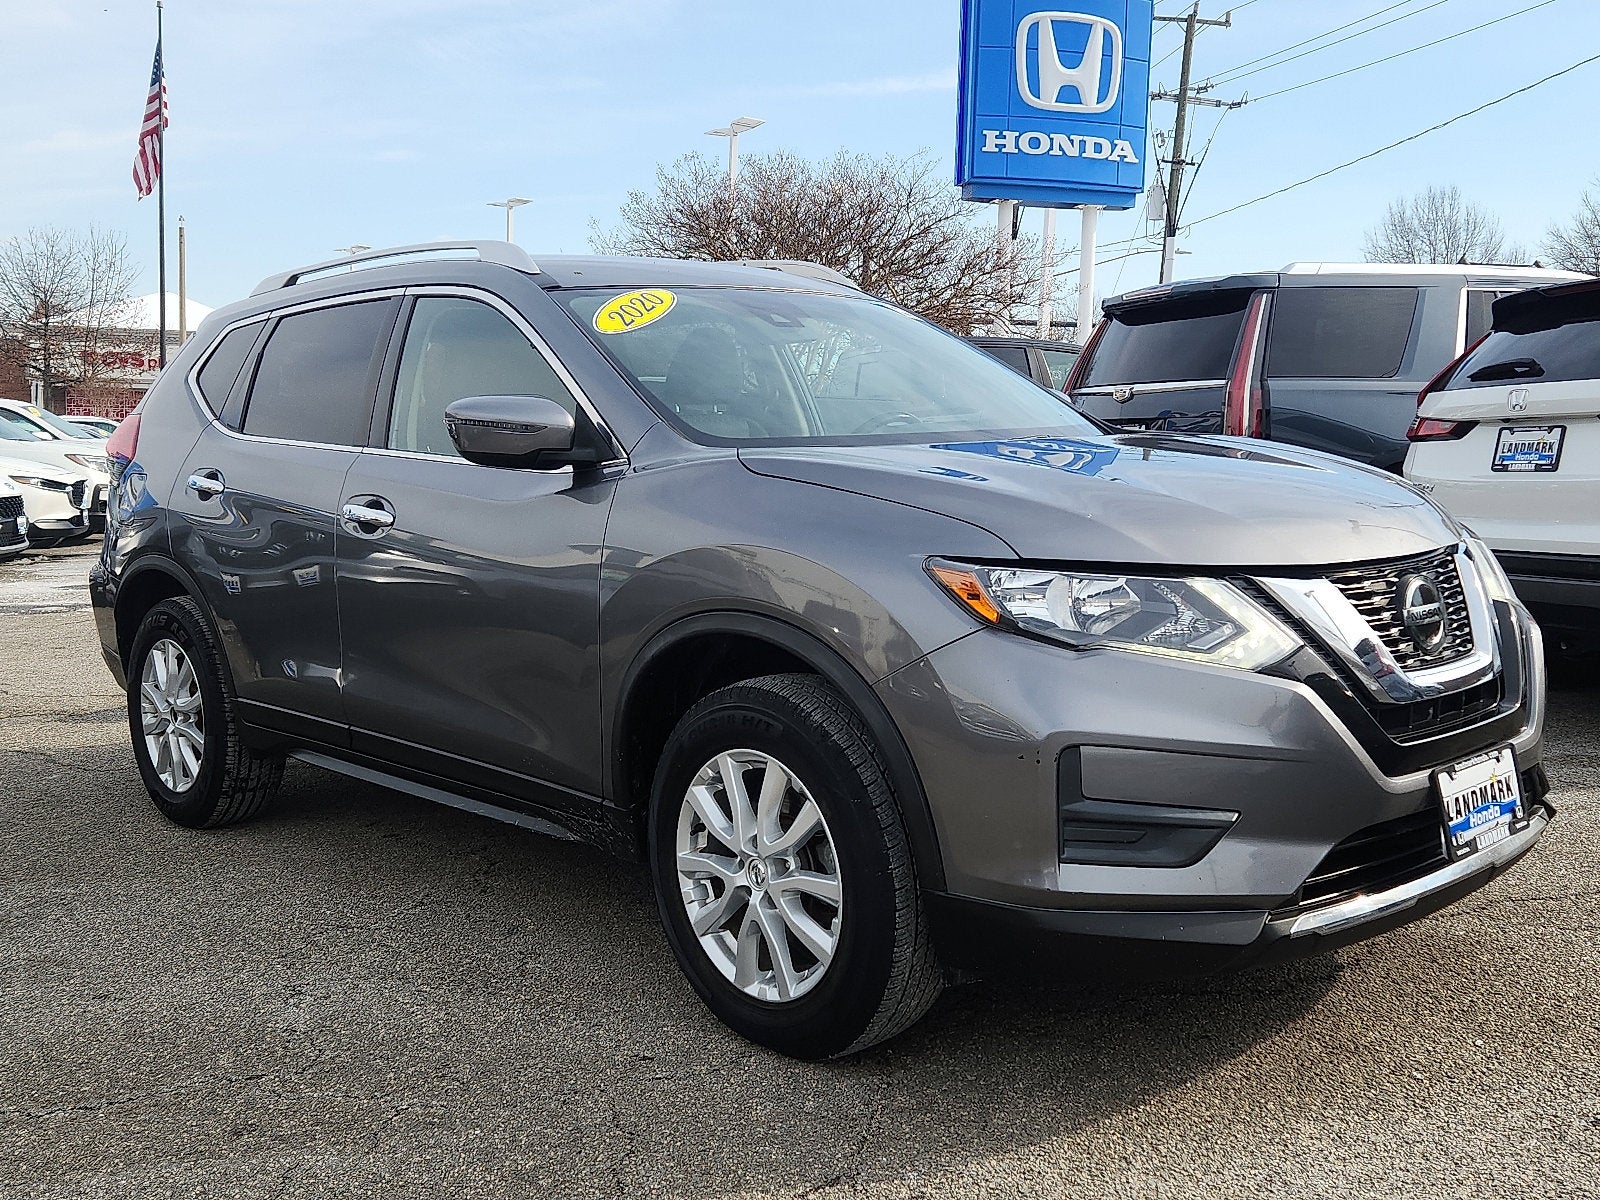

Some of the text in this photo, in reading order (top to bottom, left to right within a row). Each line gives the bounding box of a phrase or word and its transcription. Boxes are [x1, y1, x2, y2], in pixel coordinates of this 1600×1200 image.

[981, 130, 1140, 164] HONDA
[608, 292, 664, 327] 2020
[1501, 441, 1556, 454] LANDMARK
[1515, 453, 1539, 461] Honda
[1444, 775, 1514, 822] LANDMARK
[1469, 805, 1501, 828] Honda
[1475, 824, 1511, 850] LANDMARK
